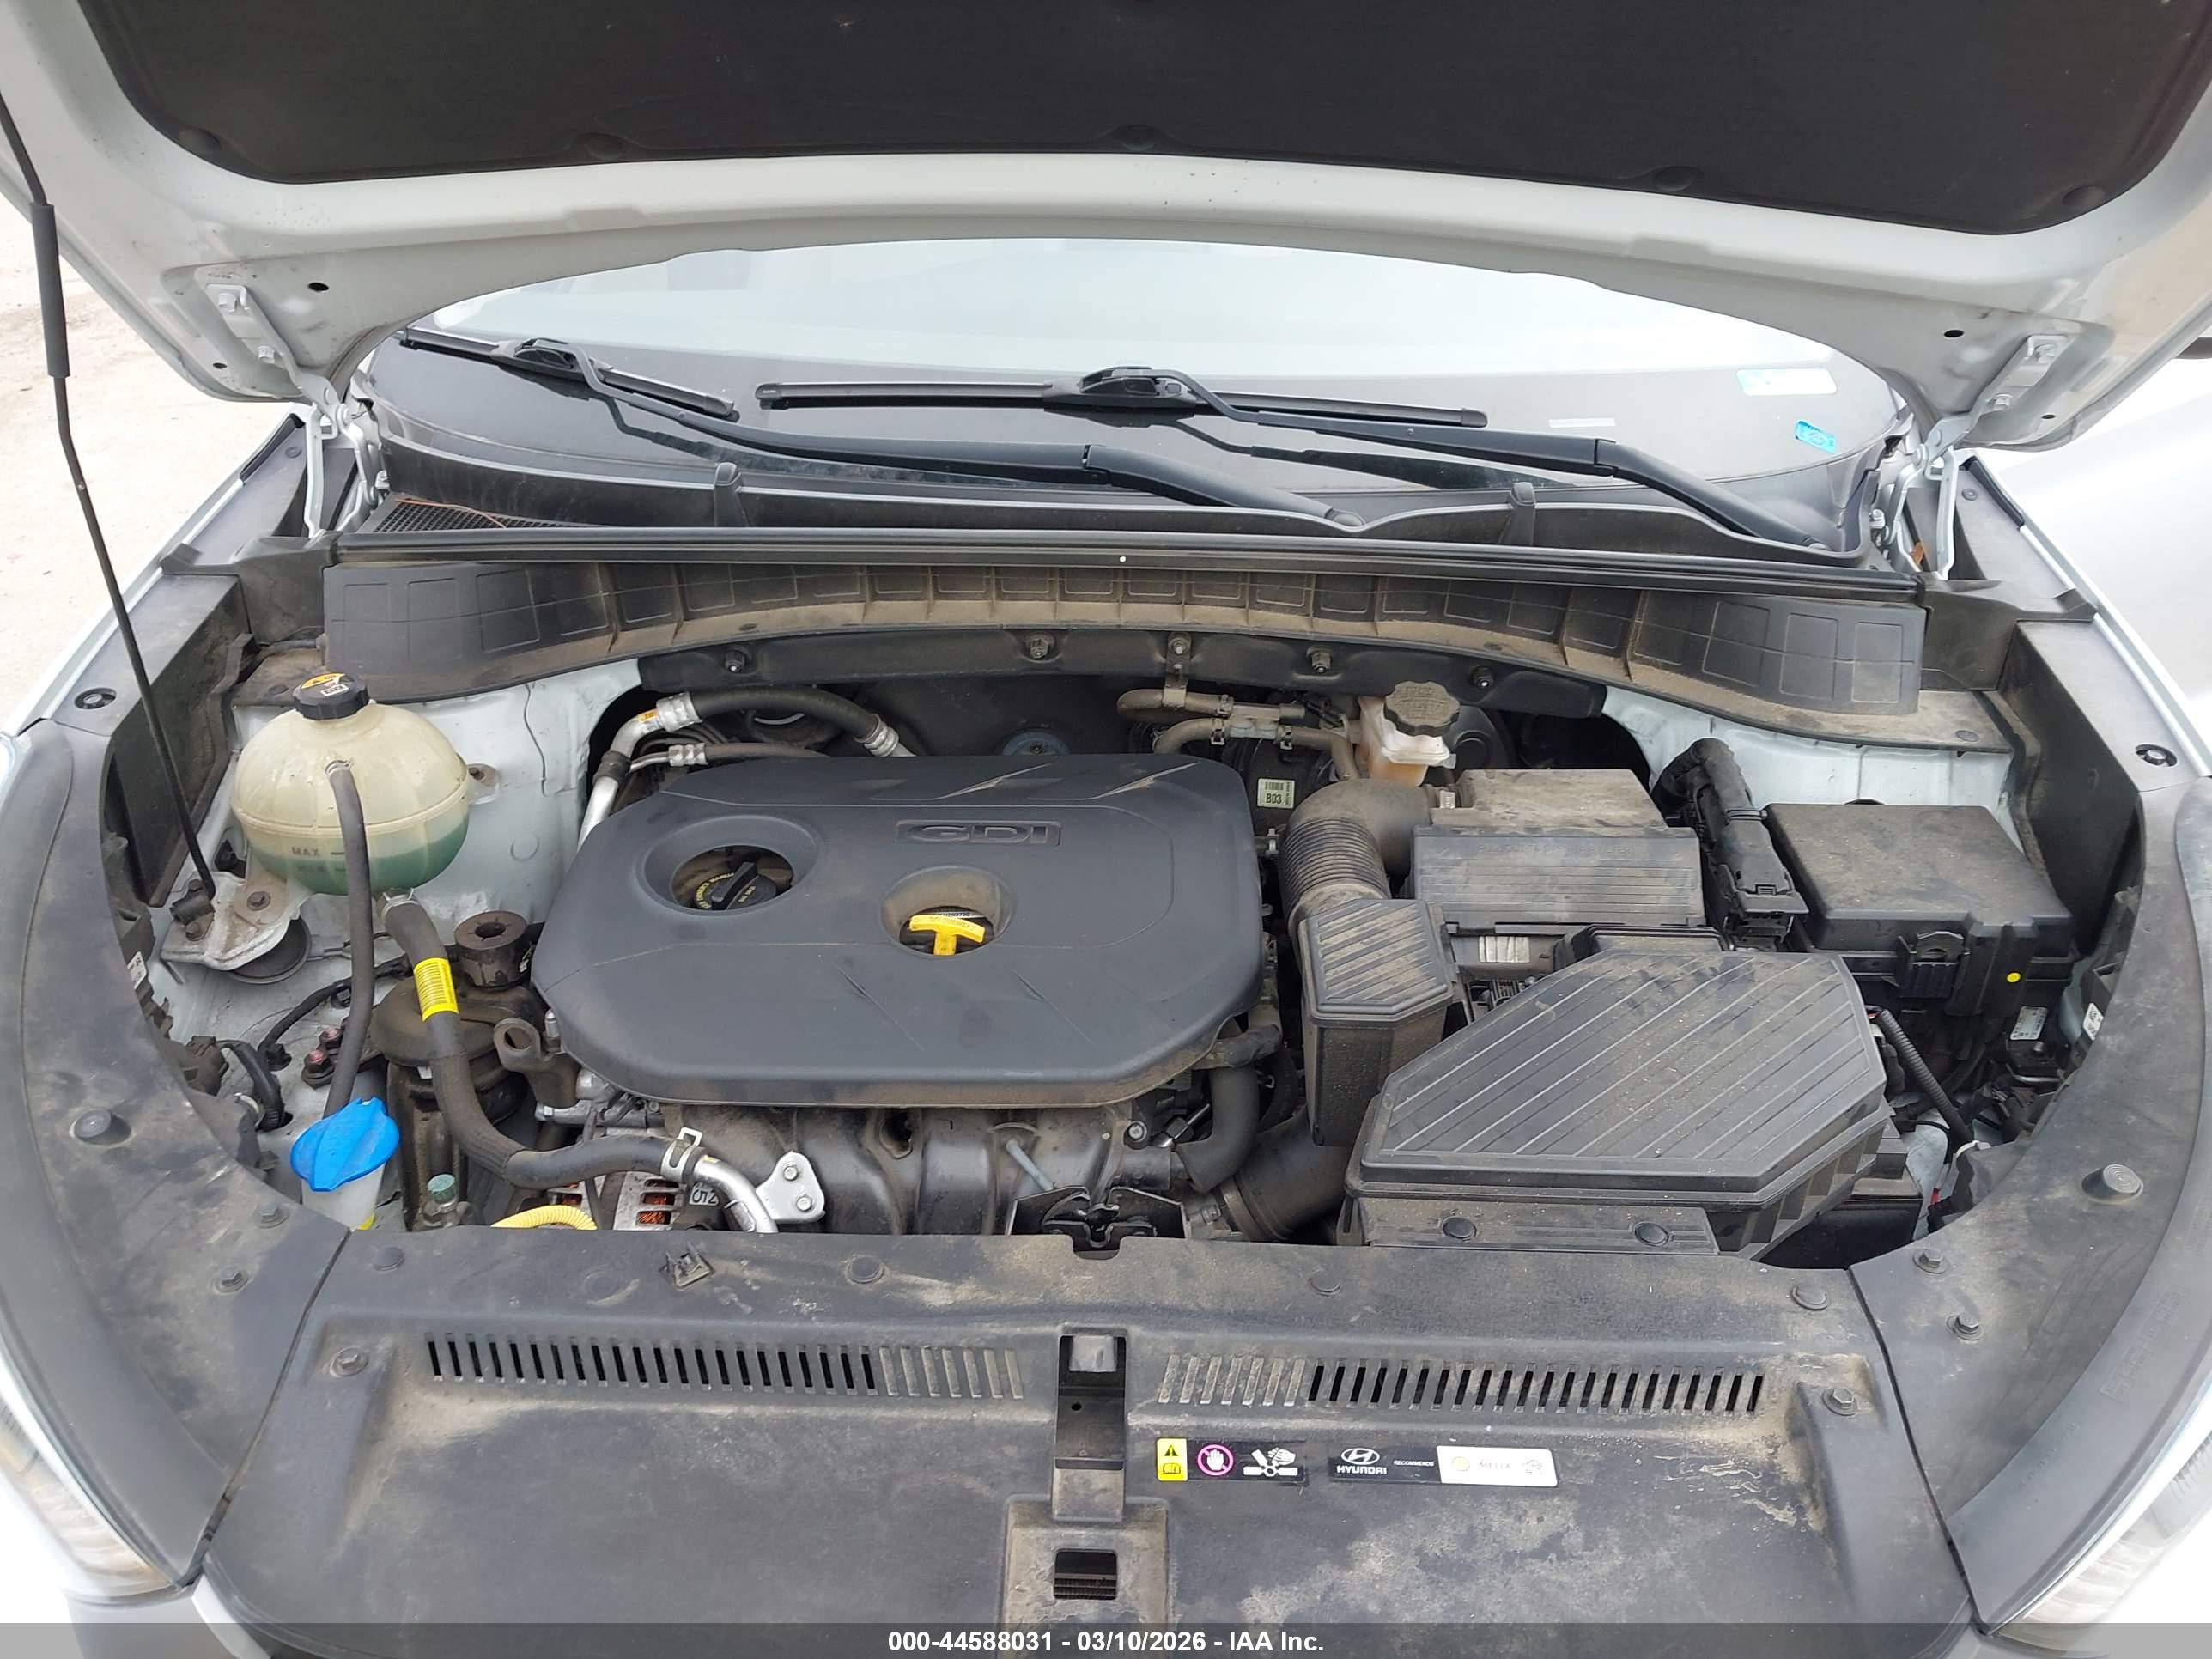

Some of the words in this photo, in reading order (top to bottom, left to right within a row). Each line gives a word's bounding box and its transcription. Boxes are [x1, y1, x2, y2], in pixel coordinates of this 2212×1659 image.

[907, 823, 1048, 843] GDI
[291, 846, 321, 857] MAX
[1336, 1465, 1388, 1475] HYUNDAI
